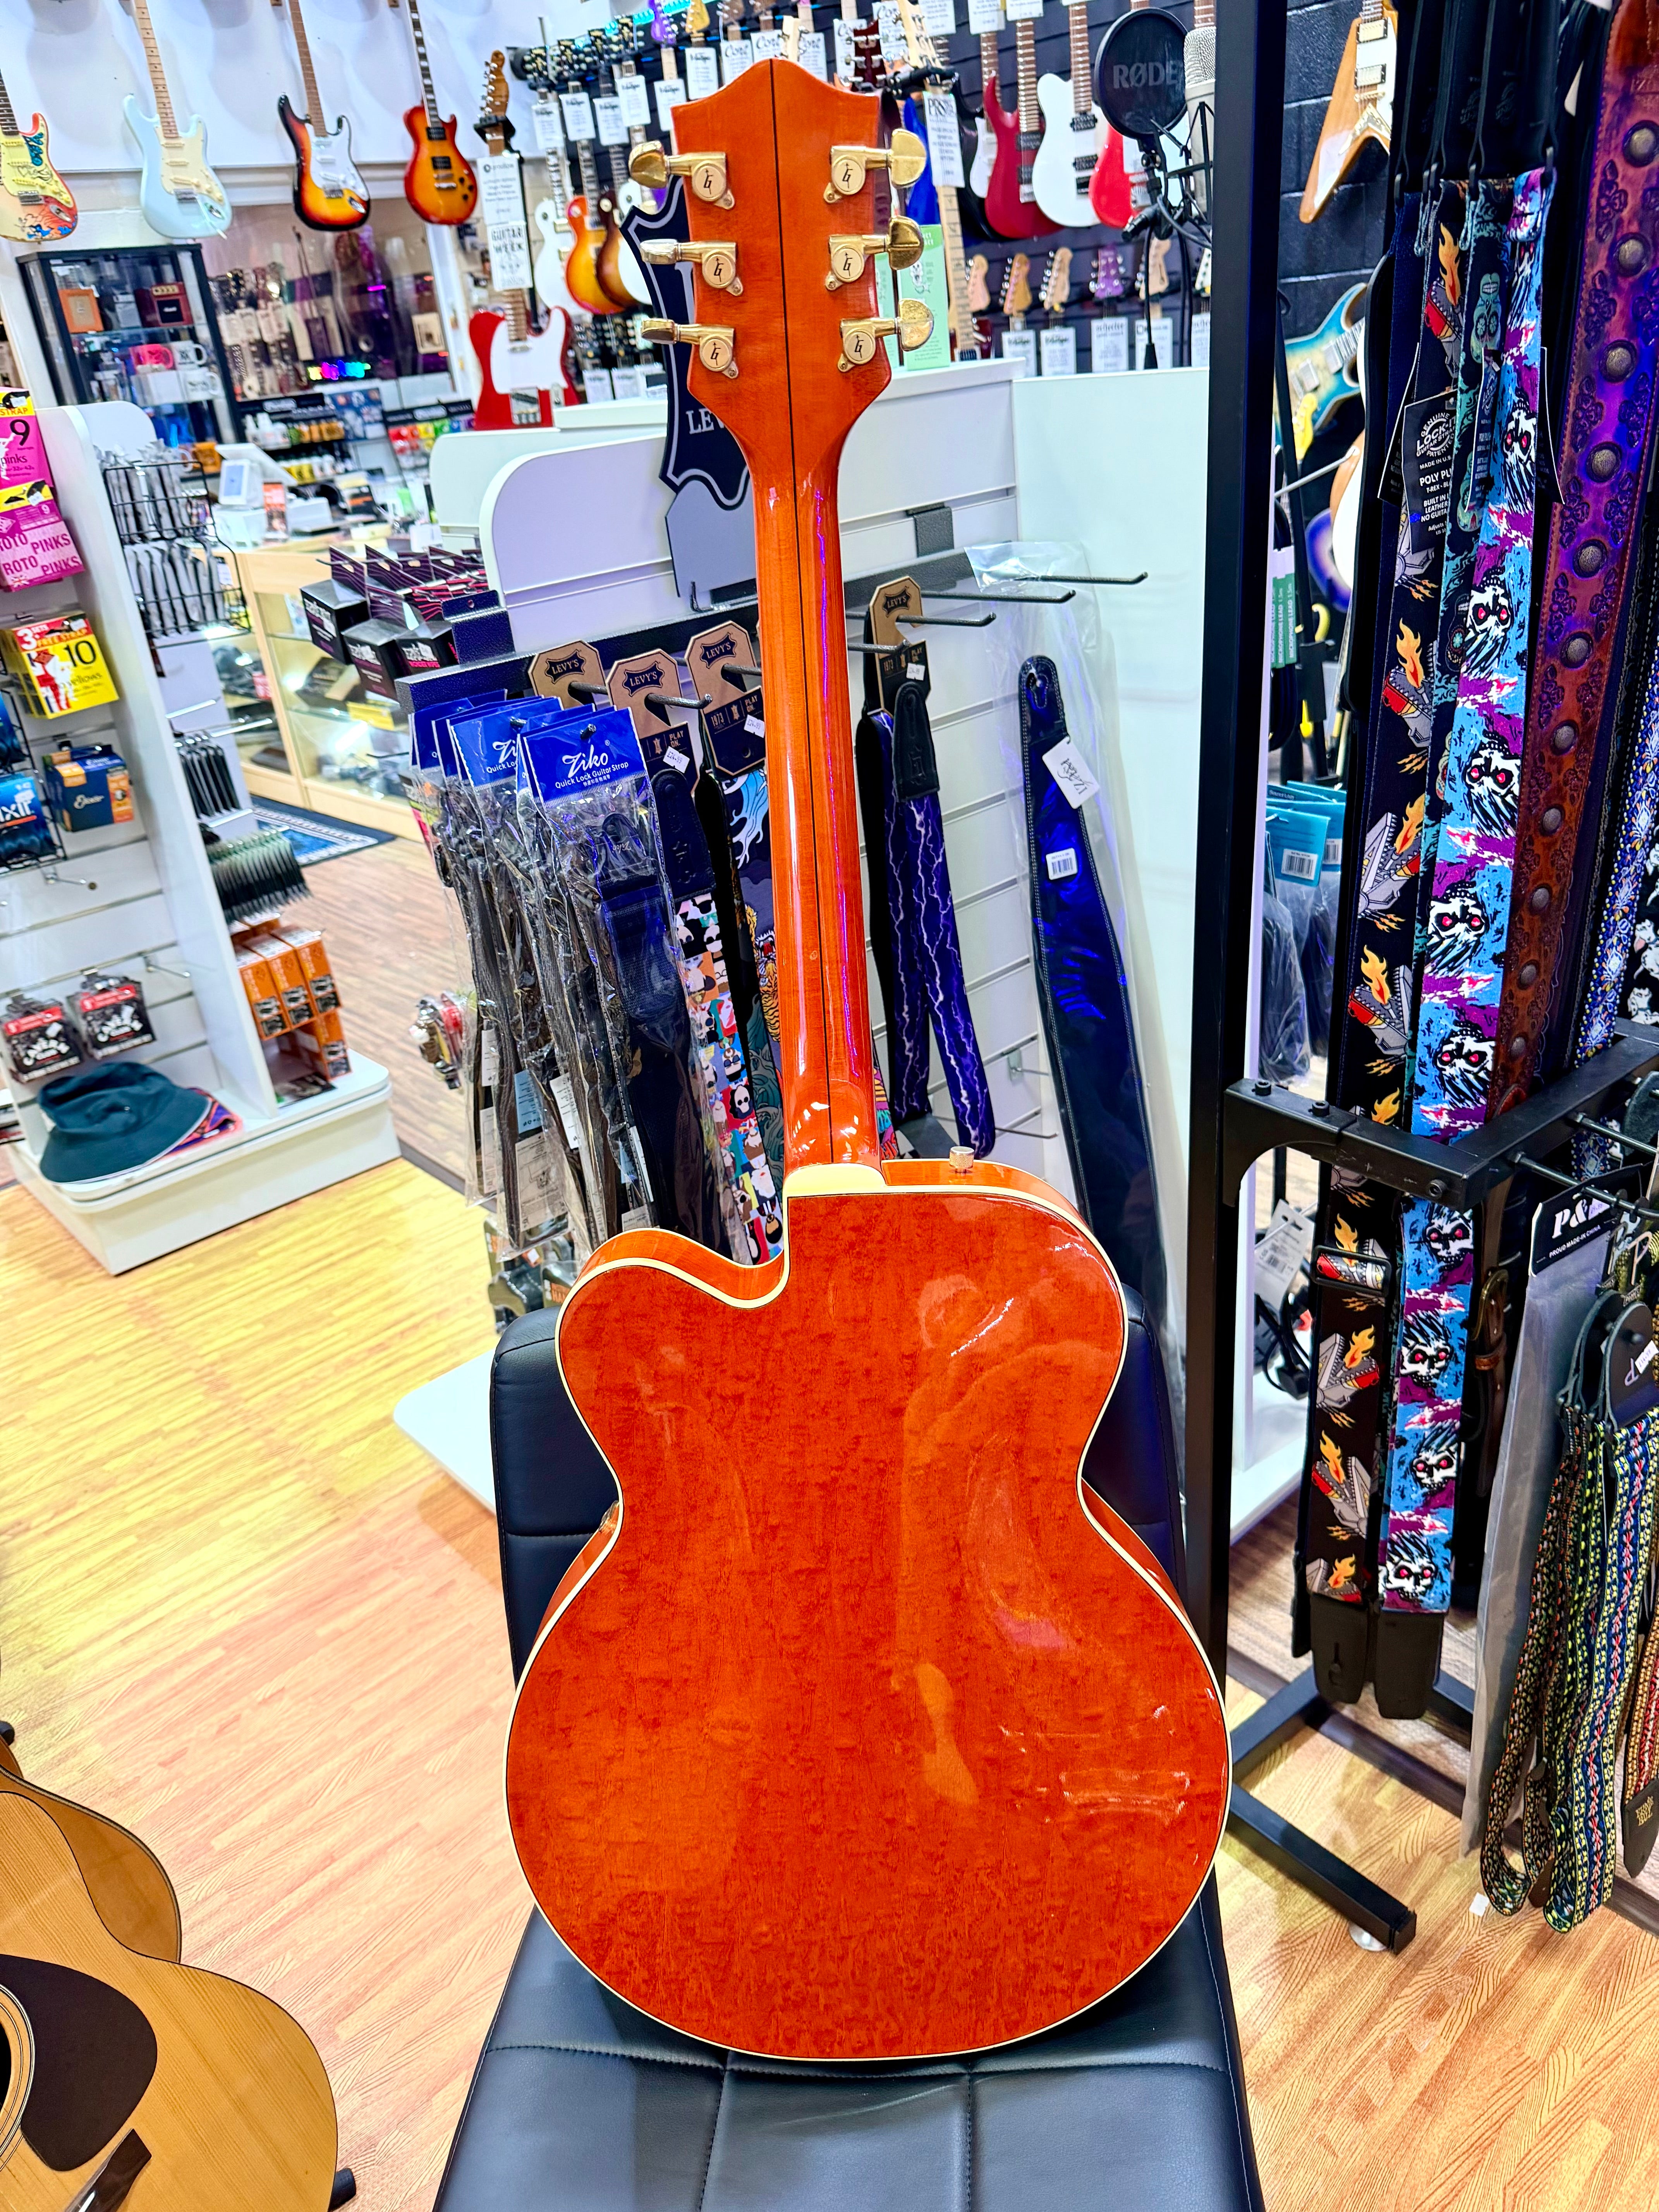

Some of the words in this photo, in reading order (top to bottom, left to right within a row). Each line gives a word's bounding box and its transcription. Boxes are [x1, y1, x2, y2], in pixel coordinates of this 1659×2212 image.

[10, 419, 30, 446] 9
[1421, 412, 1450, 437] GENUINE
[1420, 460, 1436, 470] MADE
[1419, 472, 1439, 486] POLY
[41, 504, 50, 514] 9
[1424, 496, 1439, 507] BUILT
[1425, 500, 1448, 514] LEATHER
[1421, 514, 1430, 522] NO
[1431, 508, 1447, 519] GUITA
[31, 533, 71, 555] PINKS
[2, 556, 38, 575] ROTO
[41, 556, 81, 575] PINKS
[887, 596, 907, 608] LEVY'S
[17, 628, 37, 650] 3
[63, 641, 96, 667] 10
[706, 642, 731, 658] LEVY'S
[551, 659, 579, 675] LEVY'S
[629, 671, 658, 687] LEVY'S
[711, 712, 724, 727] 1973
[745, 695, 757, 706] PLAY
[669, 730, 684, 741] PLAY
[486, 763, 506, 774] Quick
[562, 744, 608, 778] Ziko
[555, 778, 575, 789] Quick
[575, 773, 592, 783] Lock
[592, 767, 611, 778] Guitar
[611, 761, 629, 771] Strap
[1549, 1241, 1566, 1258] PROUD
[1586, 1224, 1601, 1237] CHINA
